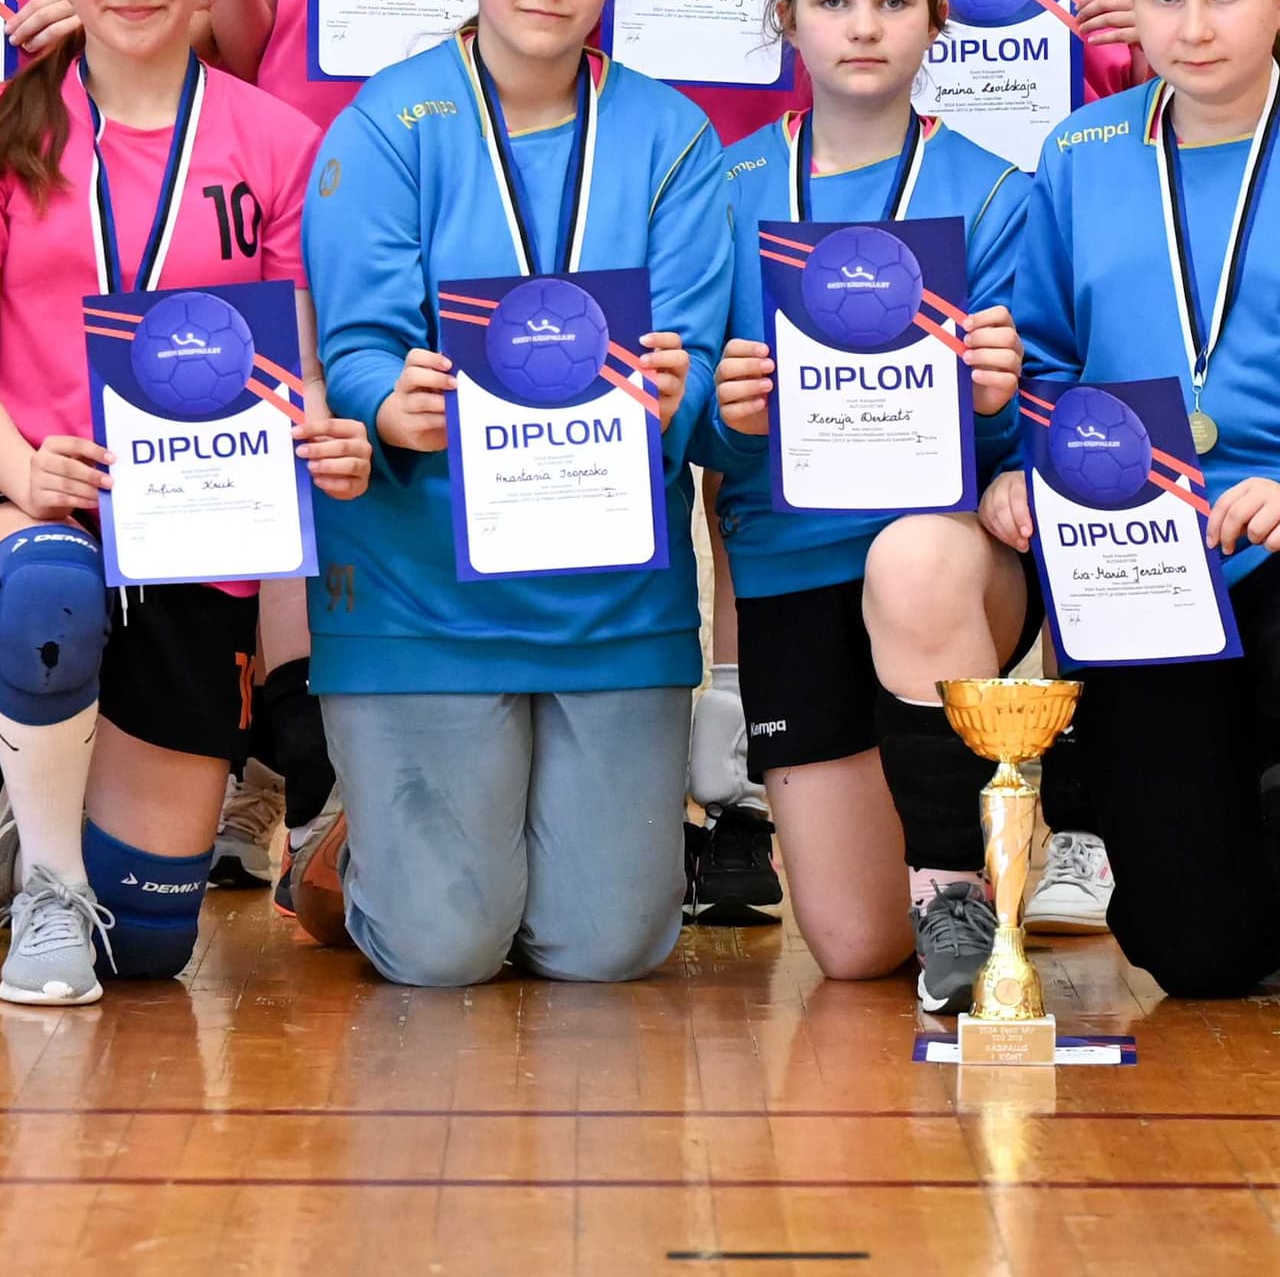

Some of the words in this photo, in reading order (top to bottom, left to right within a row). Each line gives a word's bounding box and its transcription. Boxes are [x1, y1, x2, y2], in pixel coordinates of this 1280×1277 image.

[927, 37, 1049, 64] DIPLOM
[1056, 120, 1129, 154] Kempa
[725, 156, 768, 181] empa
[202, 183, 263, 260] 10
[799, 363, 934, 391] DIPLOM
[131, 430, 269, 465] DIPLOM
[485, 417, 622, 451] DIPLOM
[1057, 519, 1179, 548] DIPLOM
[141, 881, 202, 893] DEMIX
